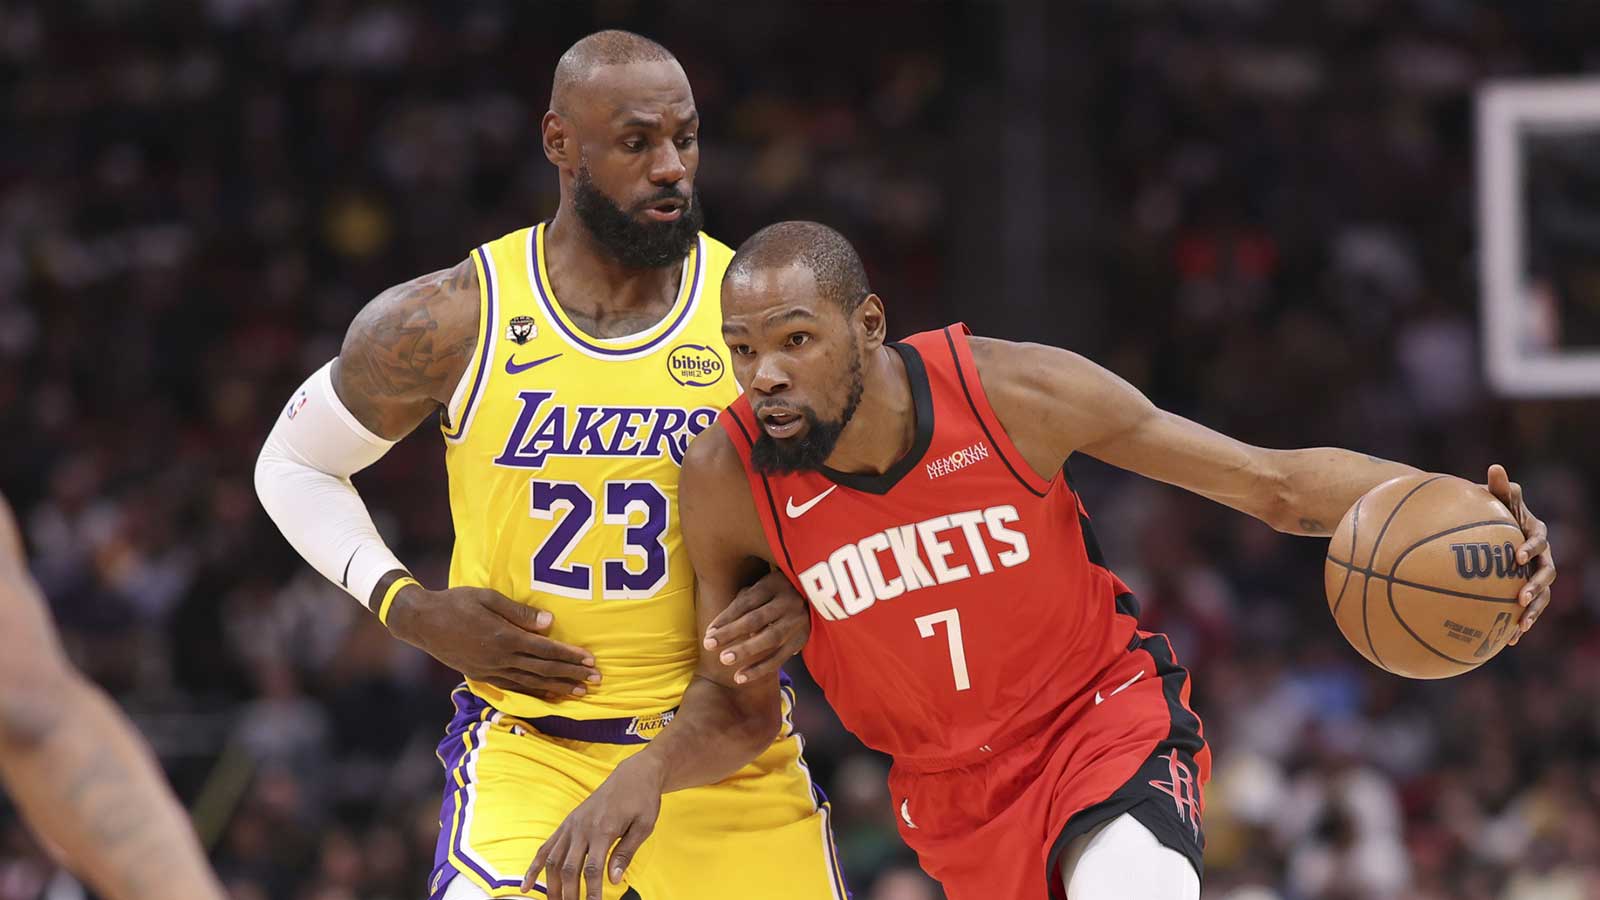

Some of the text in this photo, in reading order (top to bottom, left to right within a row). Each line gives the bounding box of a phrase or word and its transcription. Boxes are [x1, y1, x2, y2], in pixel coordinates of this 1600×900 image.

[672, 355, 721, 375] bibigo
[926, 441, 988, 471] MEMORIAL
[927, 447, 989, 480] HERMANN
[529, 478, 670, 601] 23
[798, 504, 1031, 621] ROCKETS
[914, 608, 971, 692] 7
